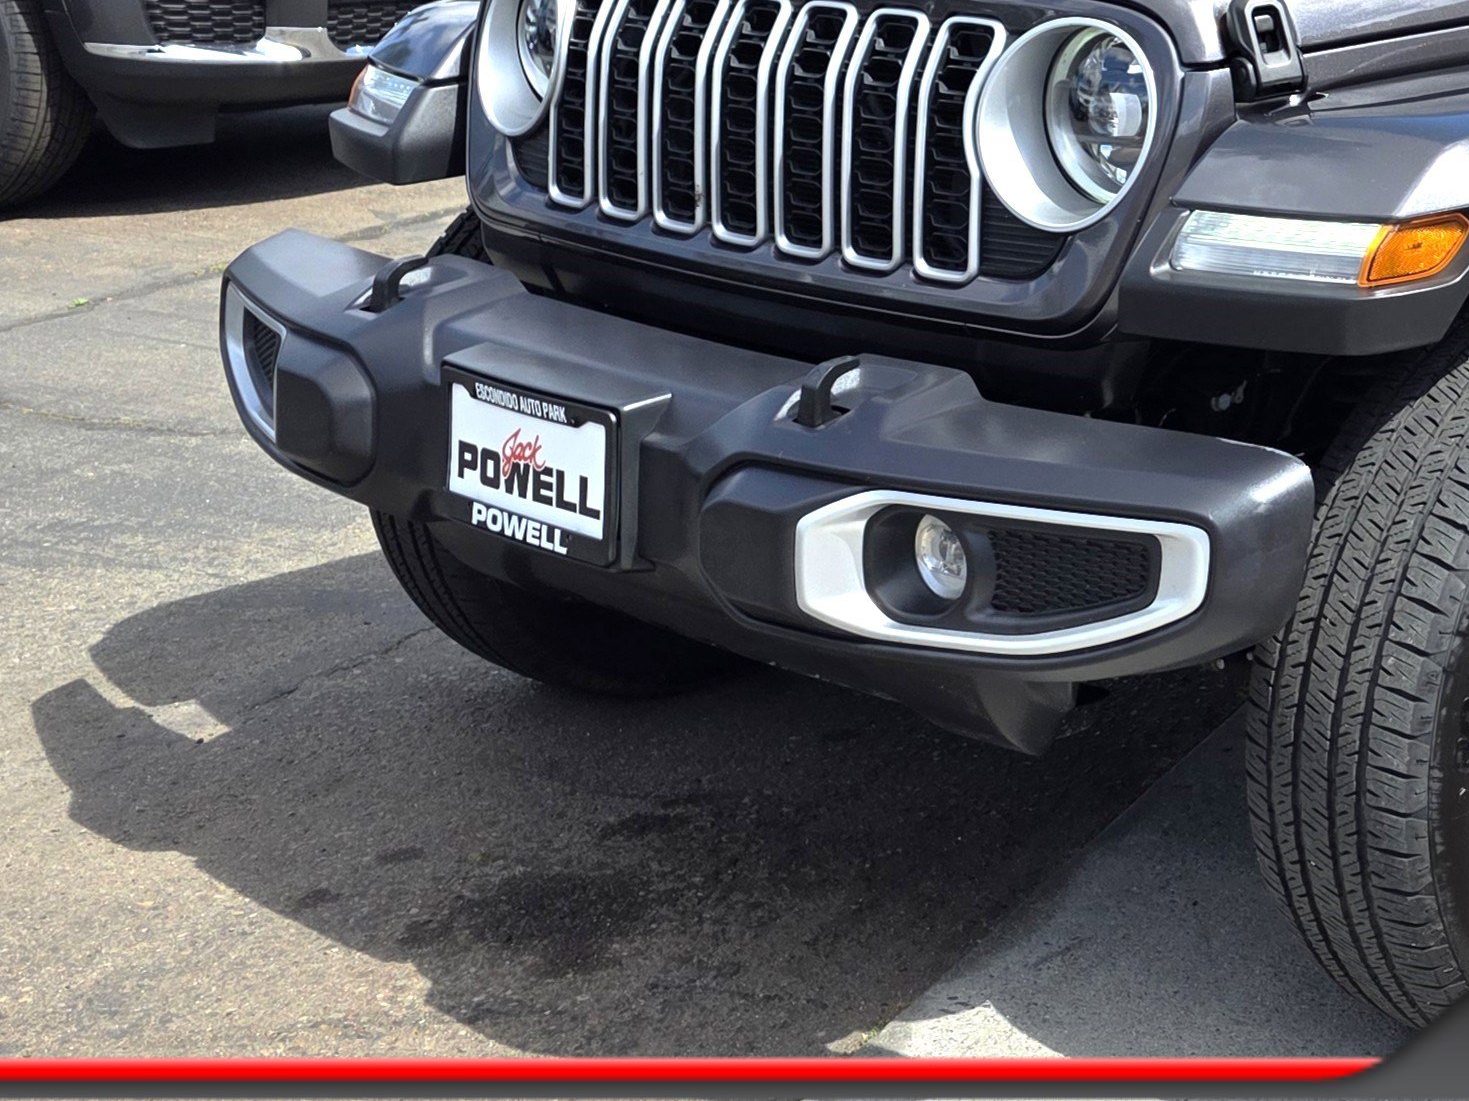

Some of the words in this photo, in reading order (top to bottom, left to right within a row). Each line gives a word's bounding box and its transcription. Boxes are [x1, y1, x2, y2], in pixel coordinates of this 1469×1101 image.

[475, 382, 519, 412] ESCONDIDO
[519, 396, 542, 418] AUTO
[542, 401, 568, 423] PARK
[502, 428, 546, 479] Jack
[457, 439, 601, 521] POWELL
[471, 501, 569, 555] POWELL
